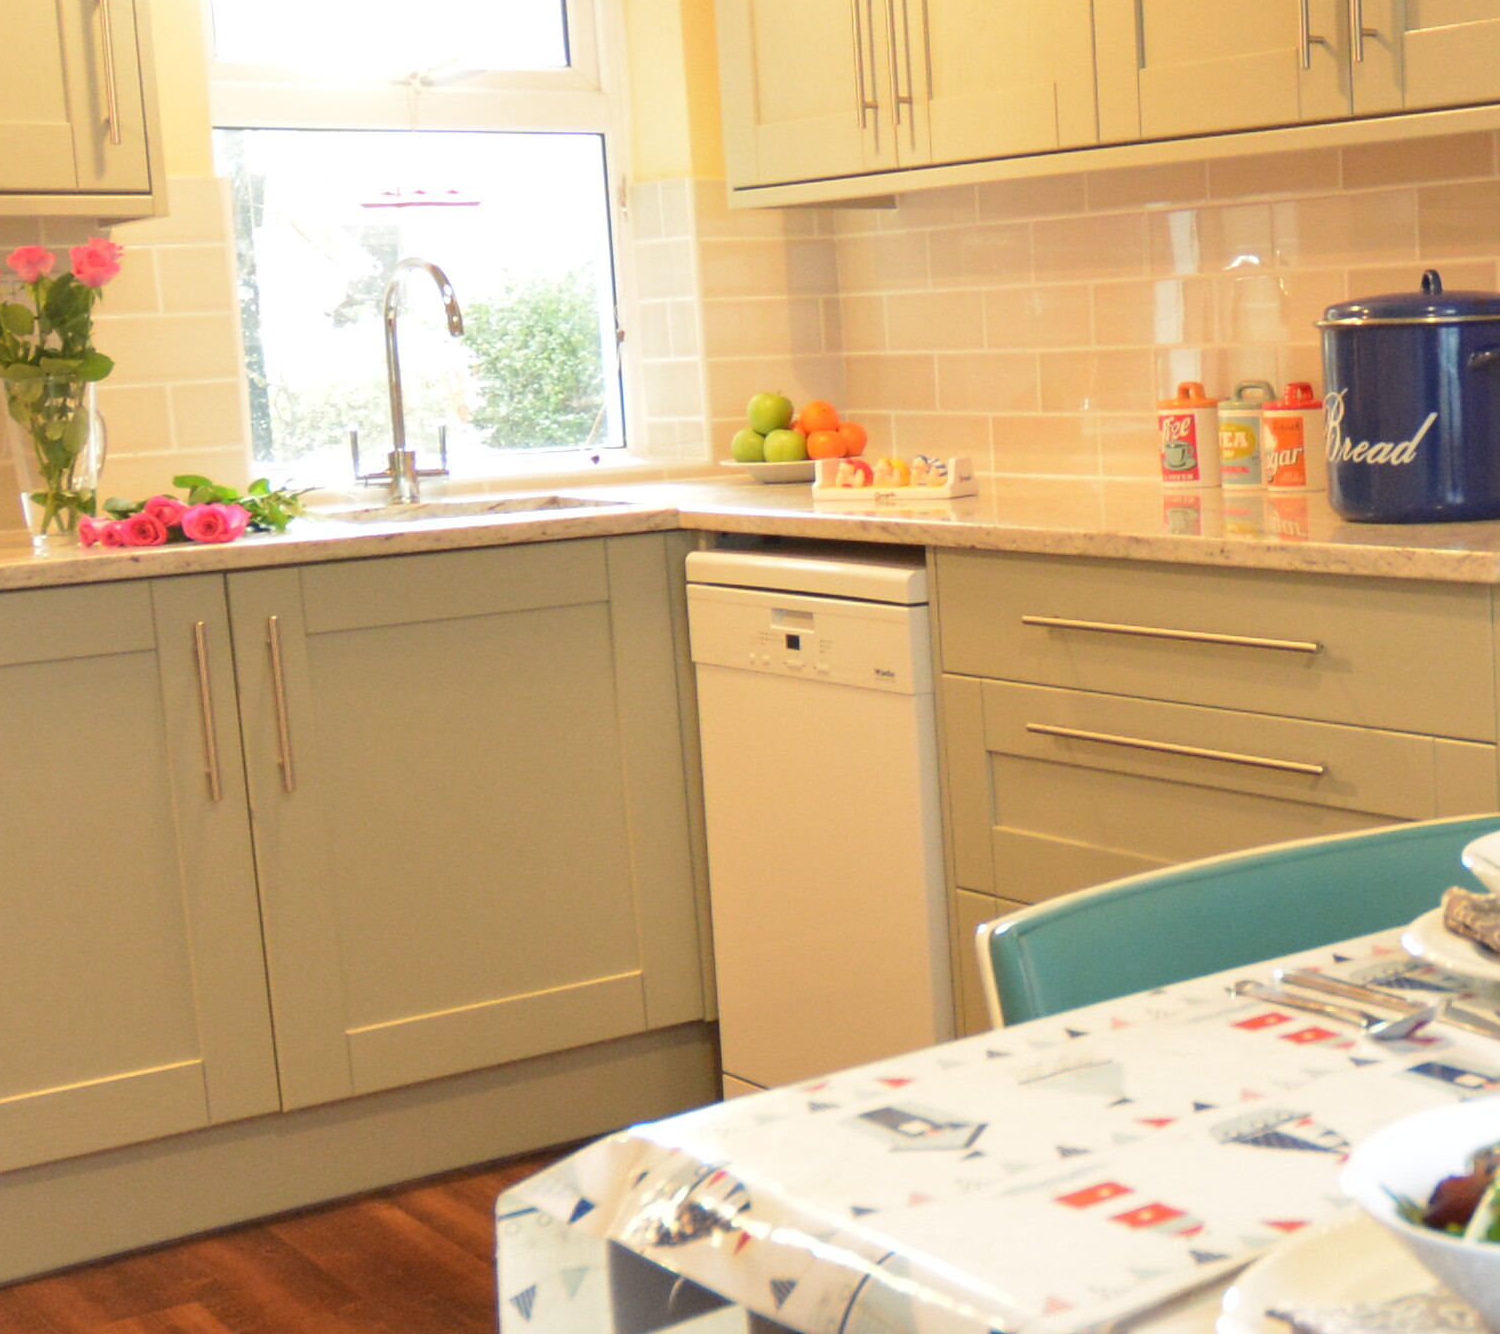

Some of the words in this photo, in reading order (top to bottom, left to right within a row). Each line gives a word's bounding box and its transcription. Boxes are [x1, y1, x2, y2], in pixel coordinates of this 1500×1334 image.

[1161, 416, 1191, 444] ffee
[1323, 387, 1438, 465] Bread
[1267, 447, 1304, 476] gar
